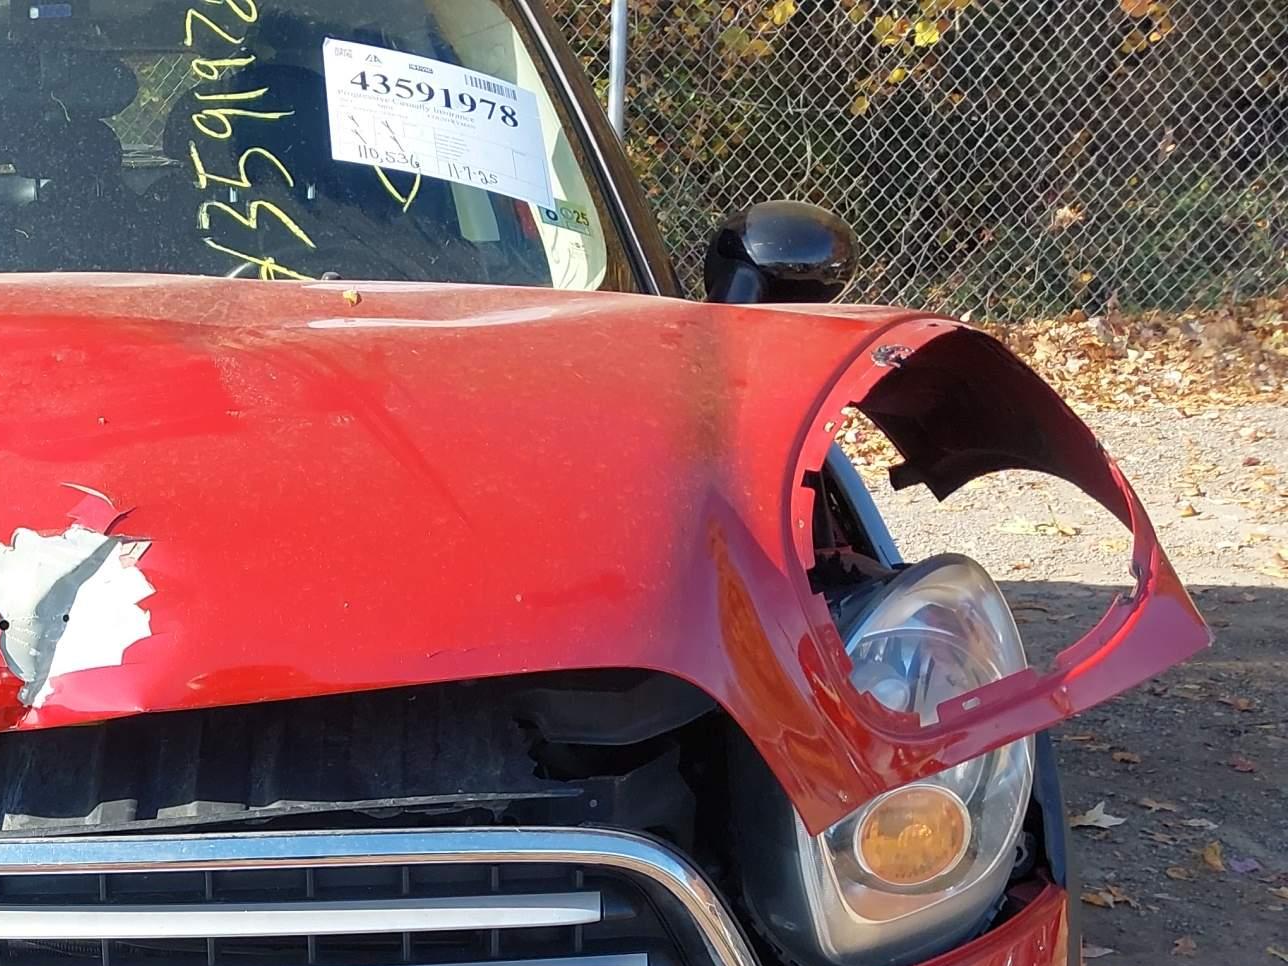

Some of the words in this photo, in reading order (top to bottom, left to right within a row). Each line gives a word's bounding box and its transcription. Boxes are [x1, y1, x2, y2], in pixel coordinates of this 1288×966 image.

[350, 70, 519, 128] 43591978
[357, 144, 421, 169] 110,536
[572, 209, 591, 227] 25
